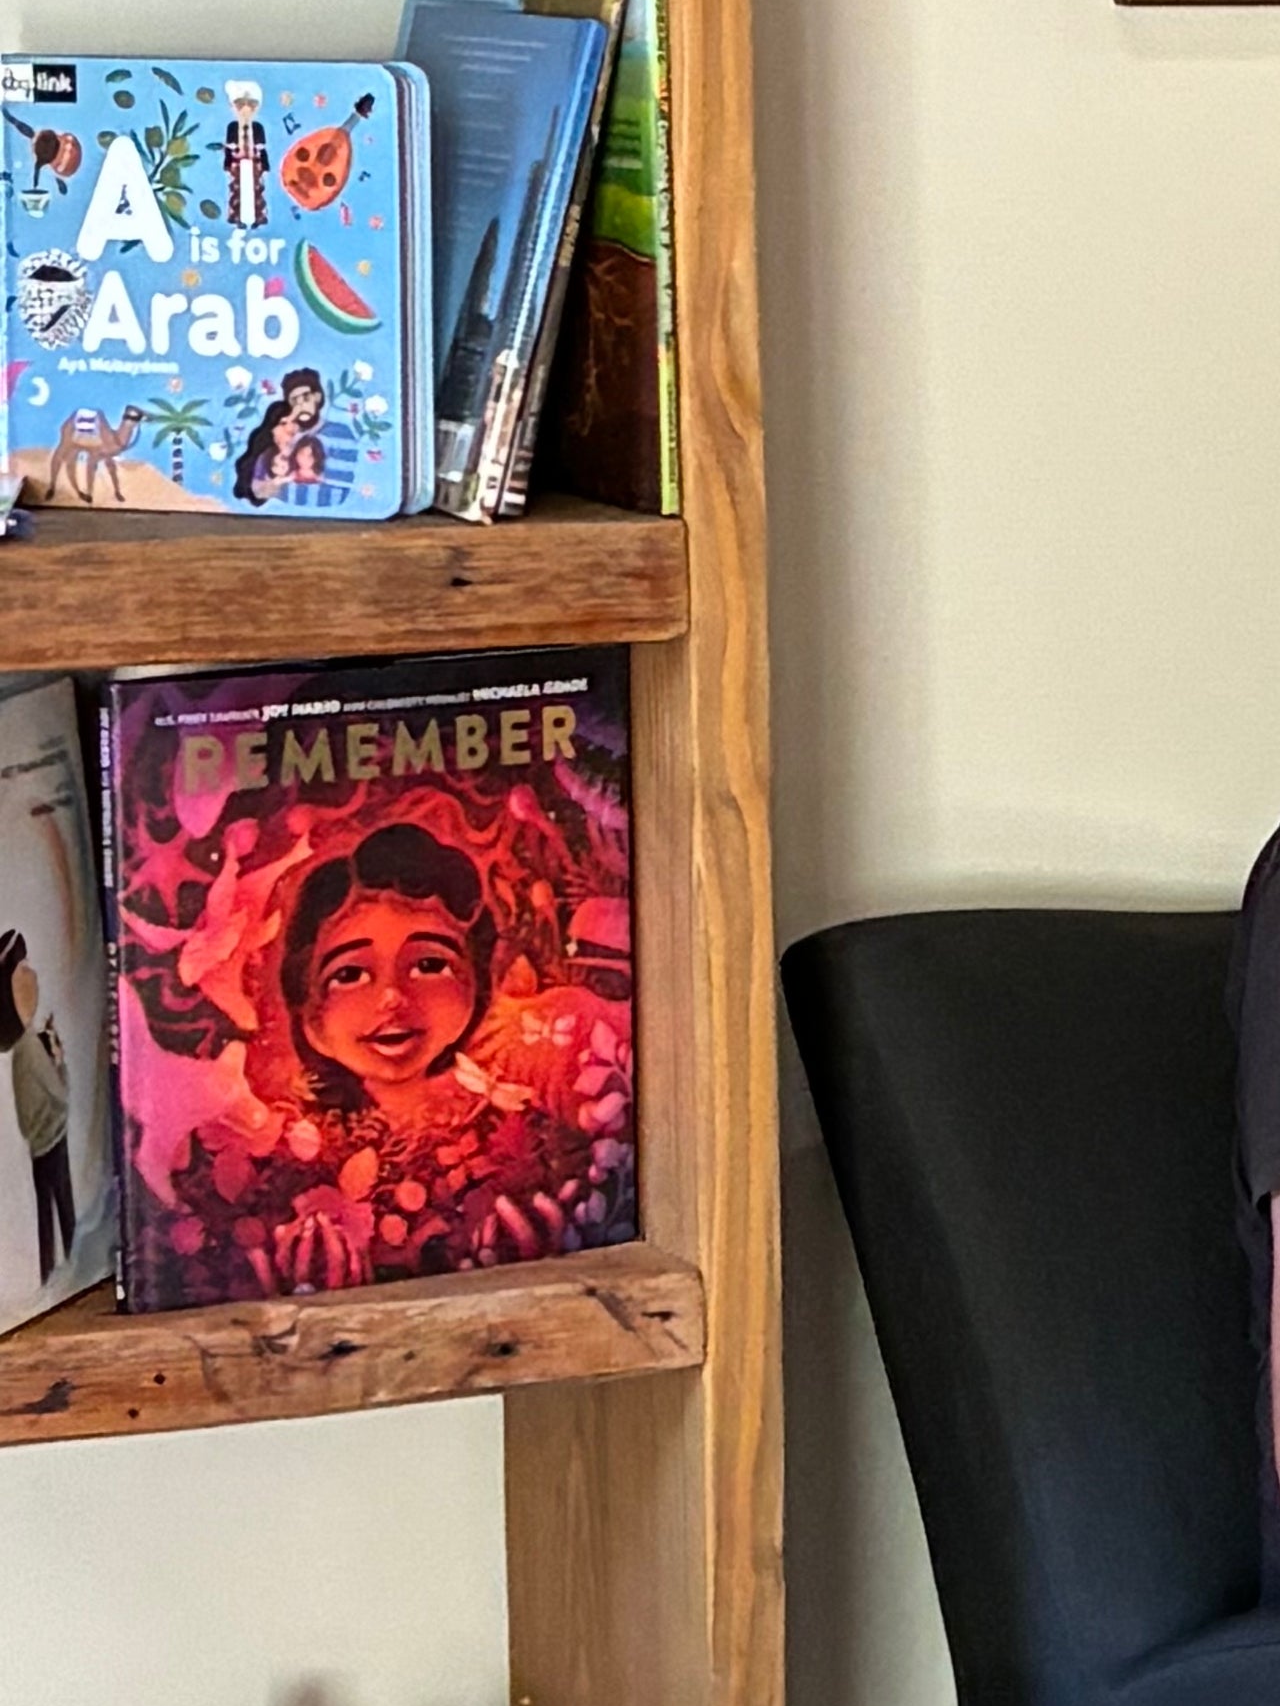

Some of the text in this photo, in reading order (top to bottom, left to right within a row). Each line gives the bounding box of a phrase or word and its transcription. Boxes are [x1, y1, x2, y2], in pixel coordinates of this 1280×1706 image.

[76, 135, 286, 265] A is for
[82, 270, 301, 359] Arab
[183, 704, 577, 794] REMEMBER
